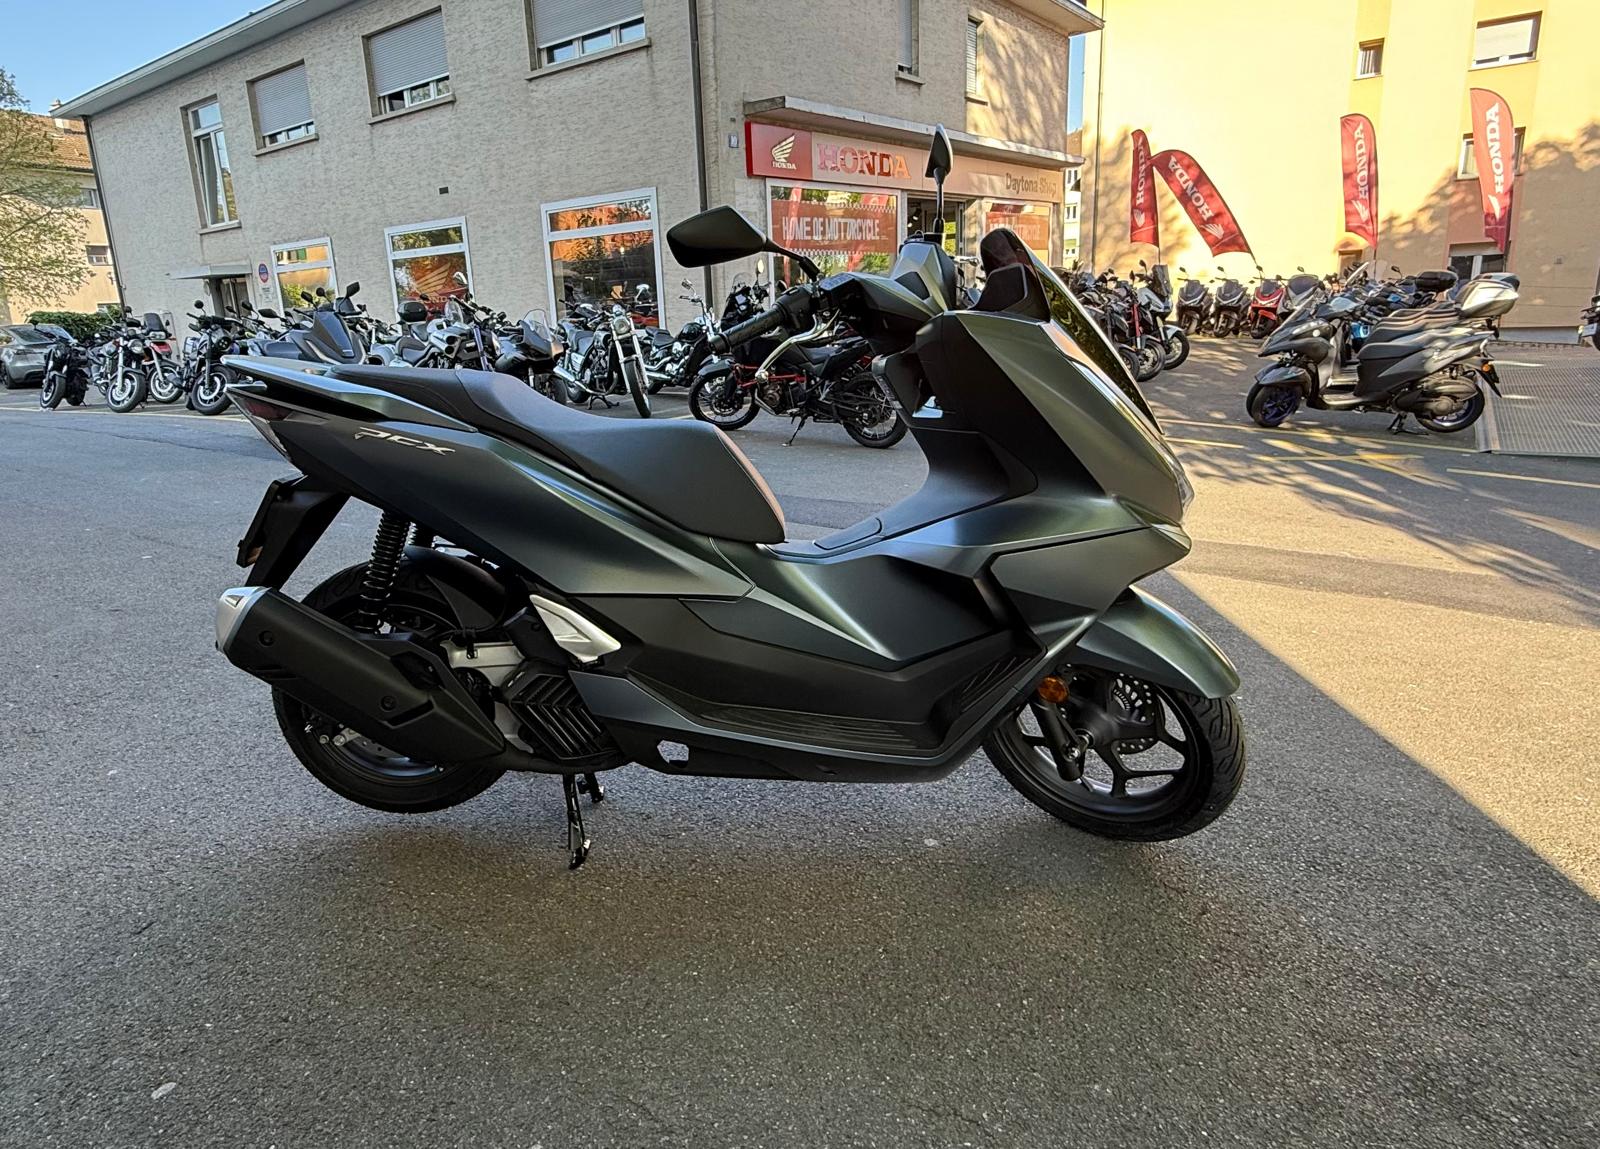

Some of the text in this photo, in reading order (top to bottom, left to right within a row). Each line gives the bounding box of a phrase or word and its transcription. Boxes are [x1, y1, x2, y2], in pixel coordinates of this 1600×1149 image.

[817, 143, 912, 179] HONDA
[1353, 122, 1369, 200] HONDA
[1486, 103, 1503, 194] HONDA
[772, 161, 797, 170] HONDA
[1005, 173, 1057, 198] Daytona Shop
[1168, 155, 1215, 221] HONDA
[782, 216, 880, 240] HOME OF MOTORCYCLE
[354, 426, 456, 456] PCX
